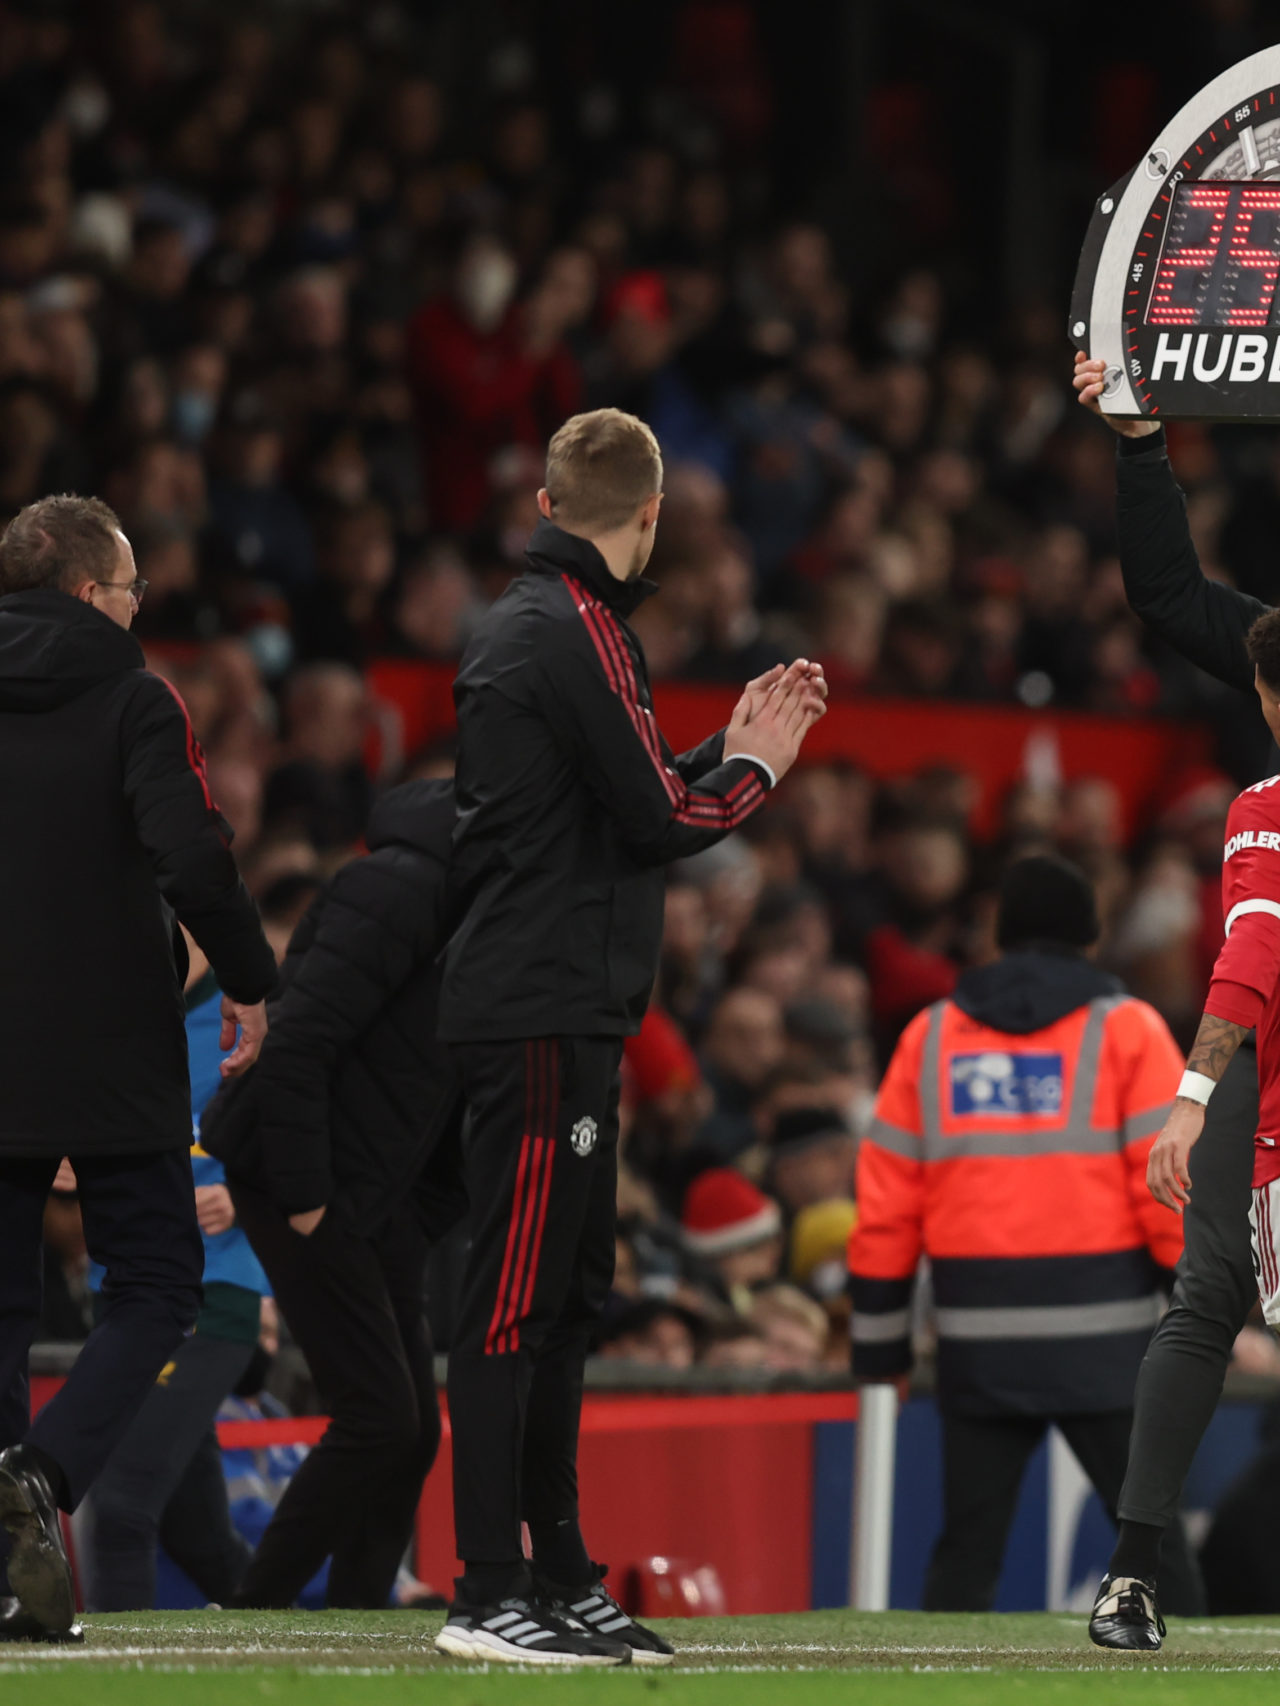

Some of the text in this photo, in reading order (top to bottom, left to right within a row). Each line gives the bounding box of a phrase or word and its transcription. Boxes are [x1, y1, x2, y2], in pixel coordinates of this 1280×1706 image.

[1234, 105, 1251, 122] 55
[1132, 263, 1144, 283] 45
[1130, 359, 1142, 377] 40
